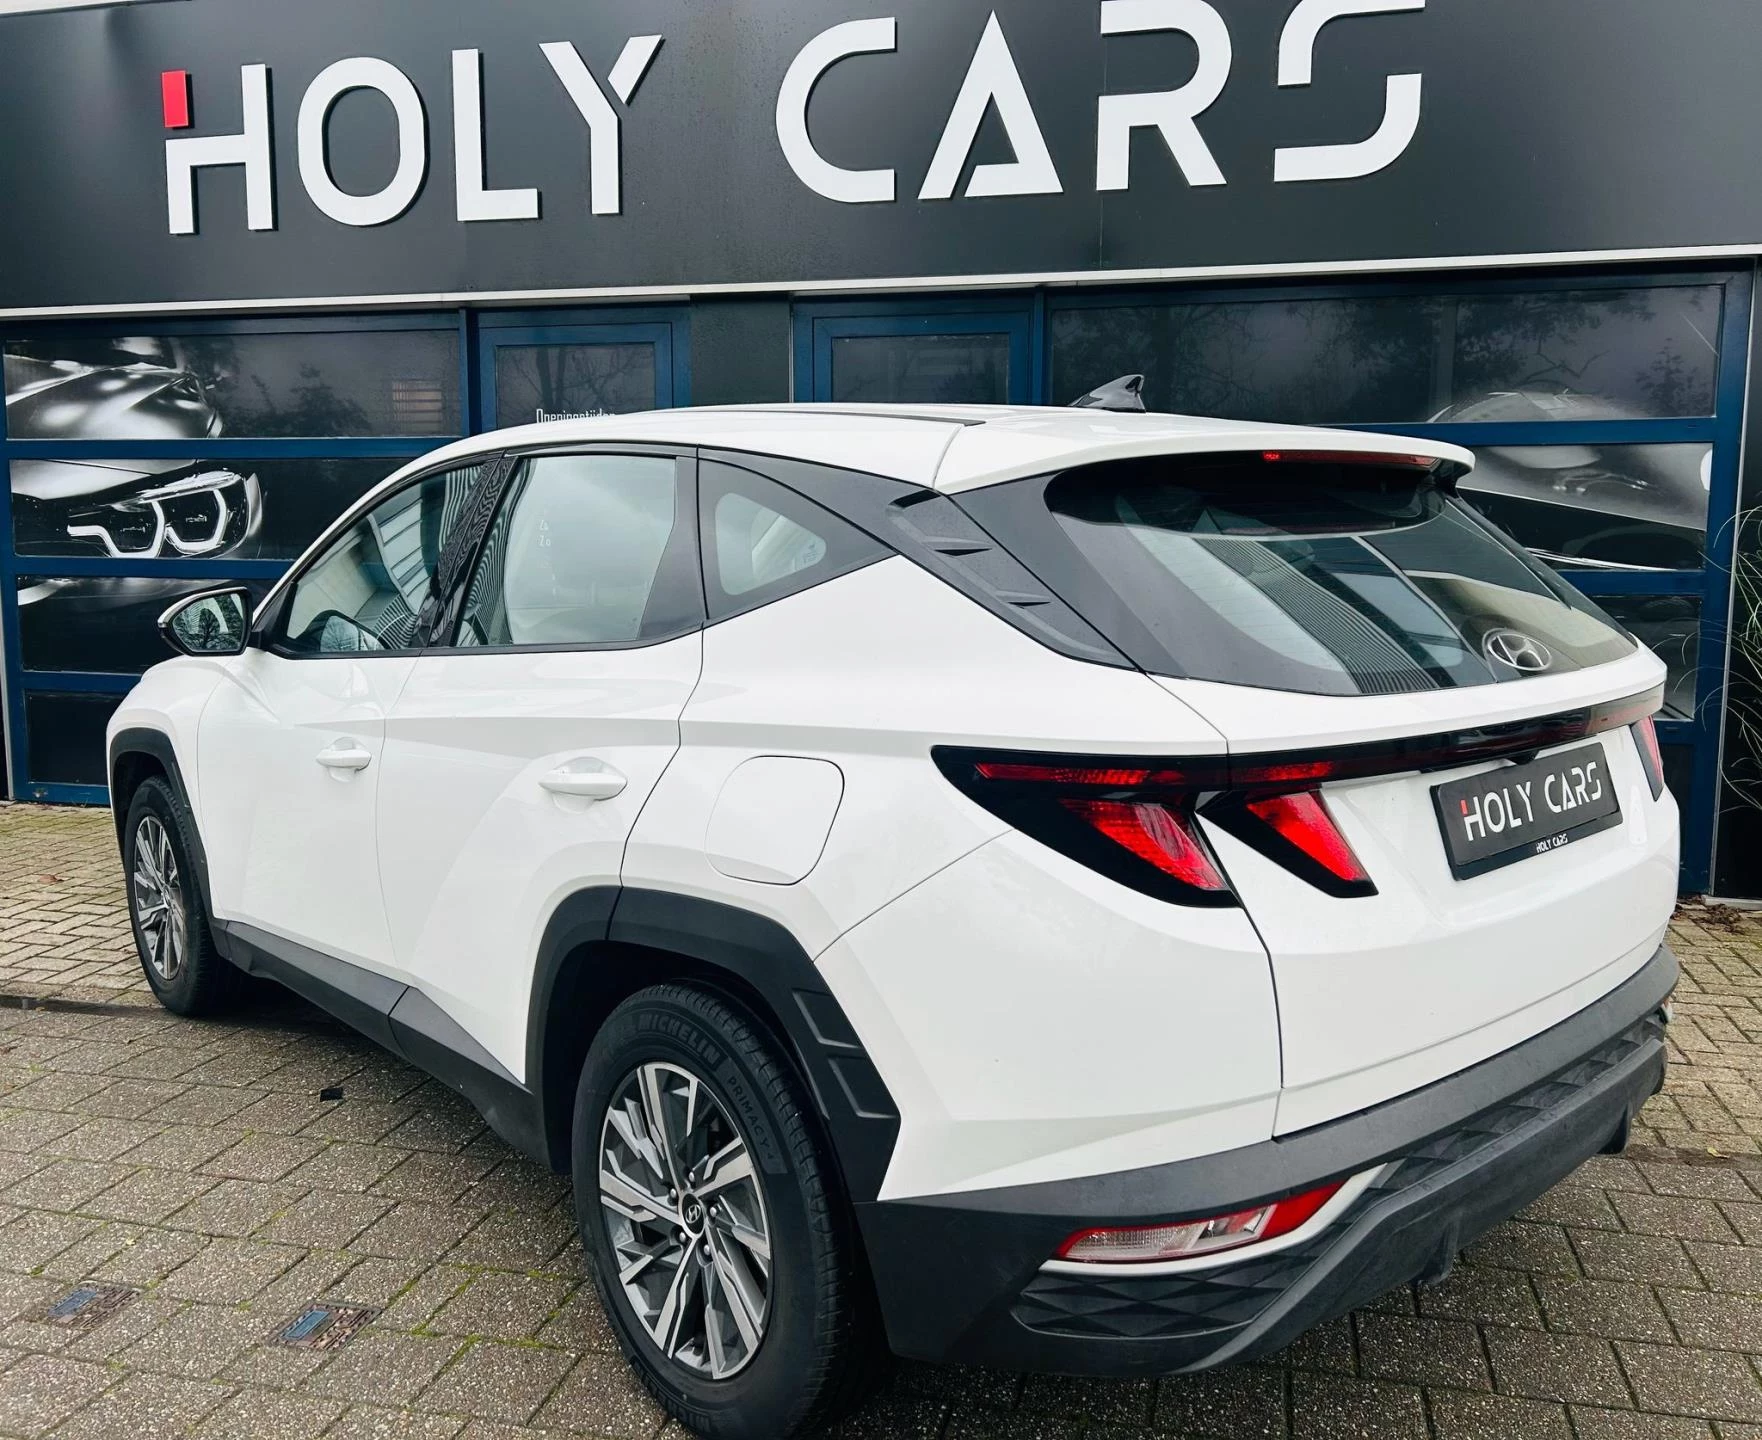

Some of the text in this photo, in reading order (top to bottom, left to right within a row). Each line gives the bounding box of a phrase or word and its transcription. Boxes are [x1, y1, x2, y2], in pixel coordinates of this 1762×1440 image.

[160, 0, 1426, 236] HOLY CARS
[536, 408, 616, 423] Openintid
[1460, 761, 1603, 842] HOLY CARS
[1536, 833, 1568, 853] HOLY CARS
[638, 1013, 723, 1068] MICHELIN
[727, 1076, 770, 1148] PRIMACY
